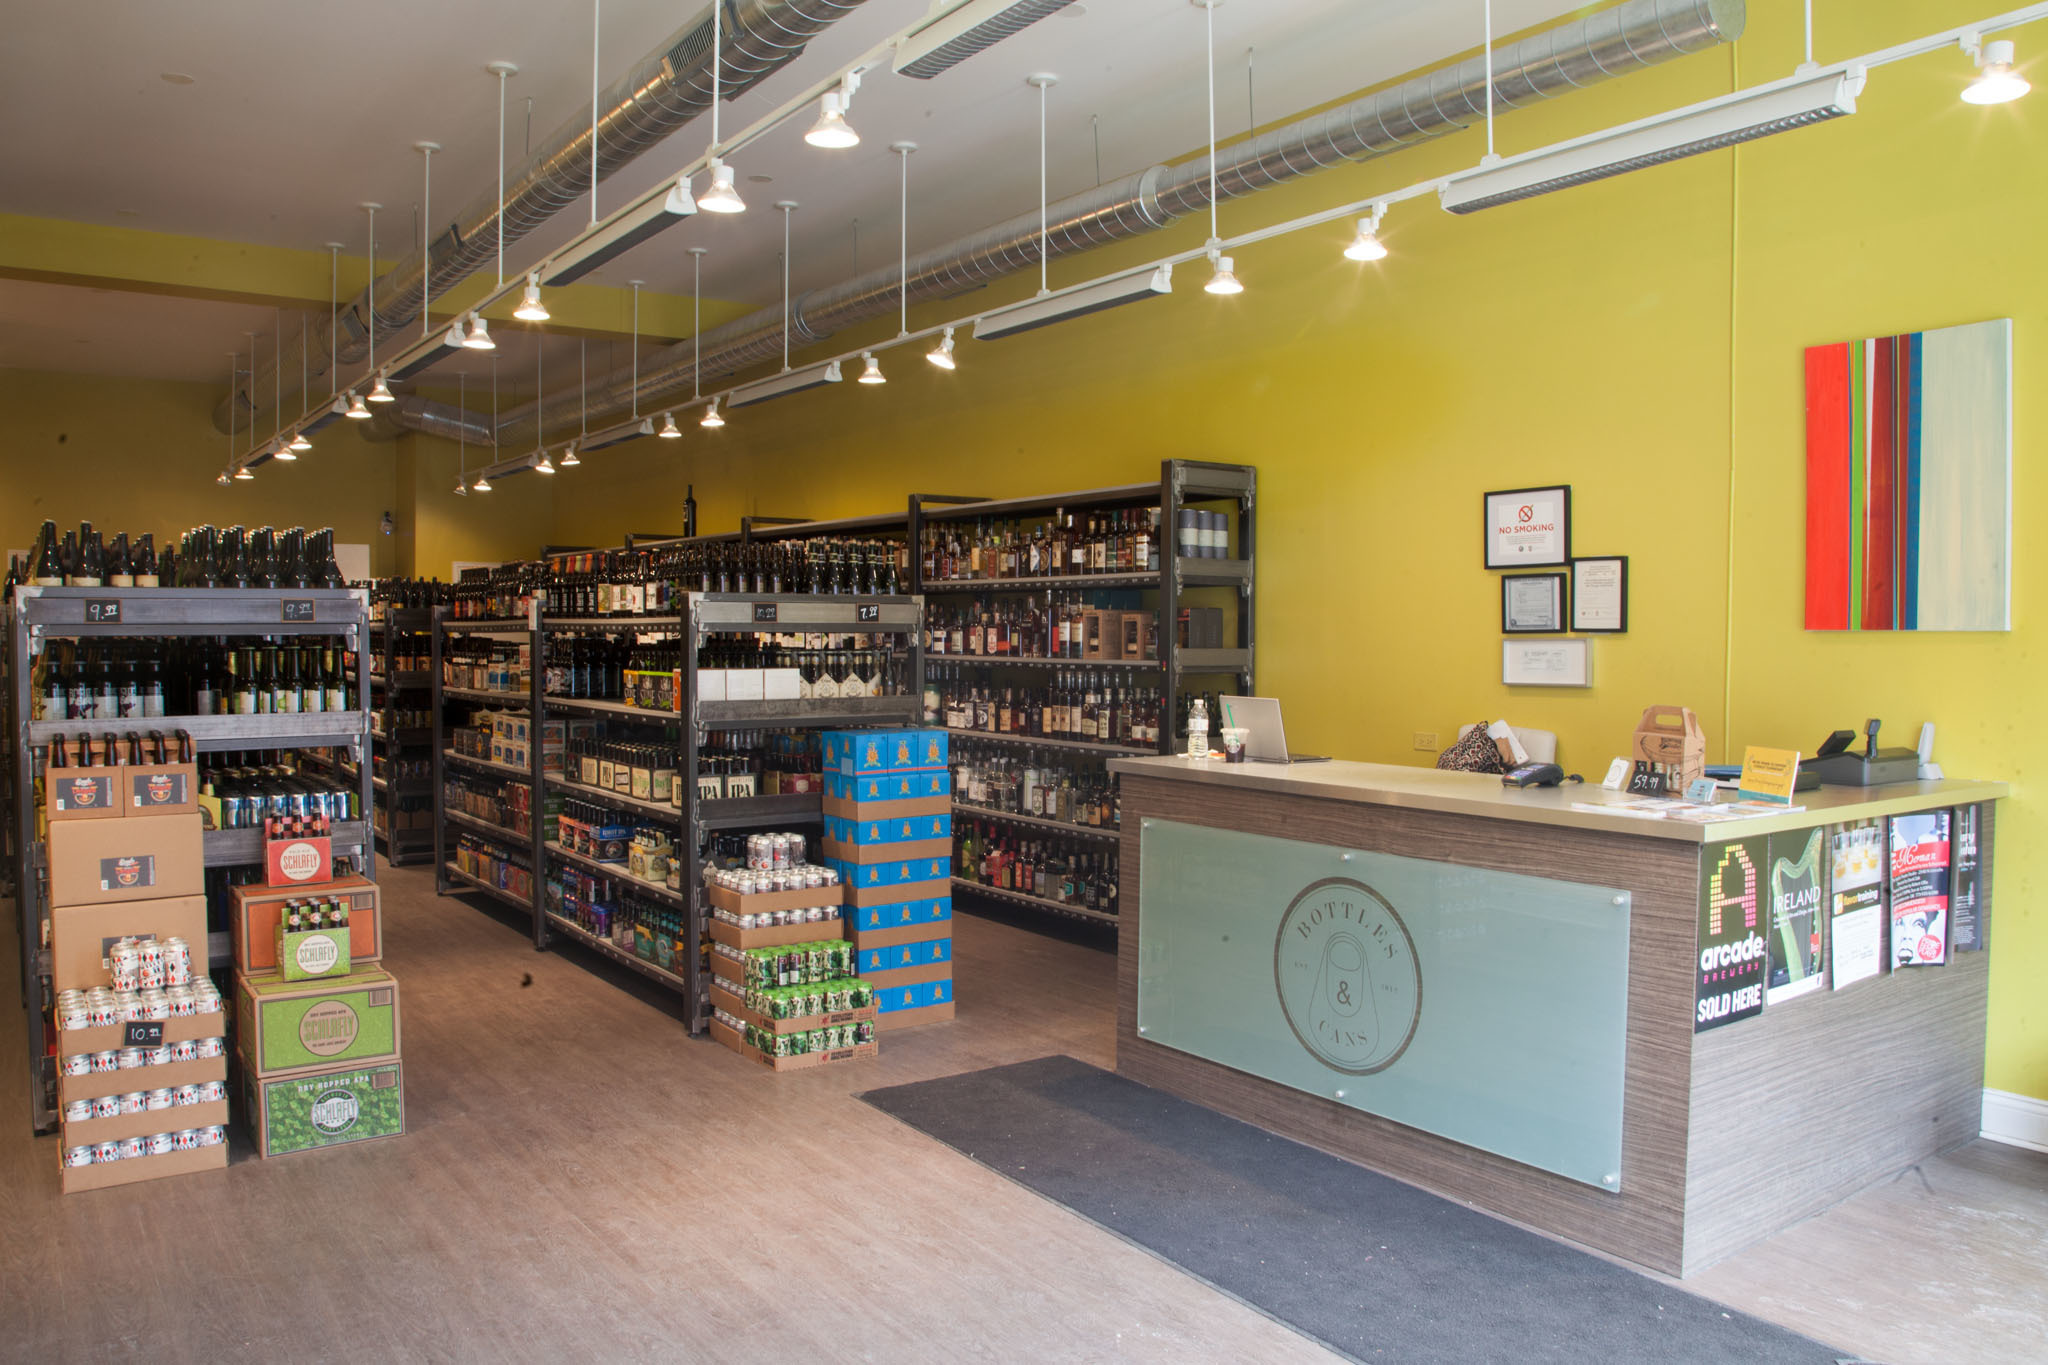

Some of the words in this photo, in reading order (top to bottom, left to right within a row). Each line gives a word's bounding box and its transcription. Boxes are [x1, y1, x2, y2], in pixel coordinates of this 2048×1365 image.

[1499, 527, 1512, 535] NO
[1514, 523, 1555, 534] SMOKING
[89, 603, 118, 621] 9.99
[731, 784, 751, 798] IPA
[1633, 774, 1660, 790] 59.99
[1773, 886, 1821, 914] IRELAND
[1297, 901, 1399, 960] BOTTLES
[1700, 931, 1765, 972] arcade
[1703, 961, 1760, 984] BREWERY
[1337, 980, 1352, 1007] &
[1697, 992, 1731, 1023] SOLD
[1732, 983, 1762, 1013] HERE
[131, 1026, 161, 1041] 10.99
[1319, 1020, 1369, 1047] CANS
[298, 1083, 314, 1092] DRY
[318, 1078, 350, 1089] HOPPED
[353, 1075, 370, 1084] APA
